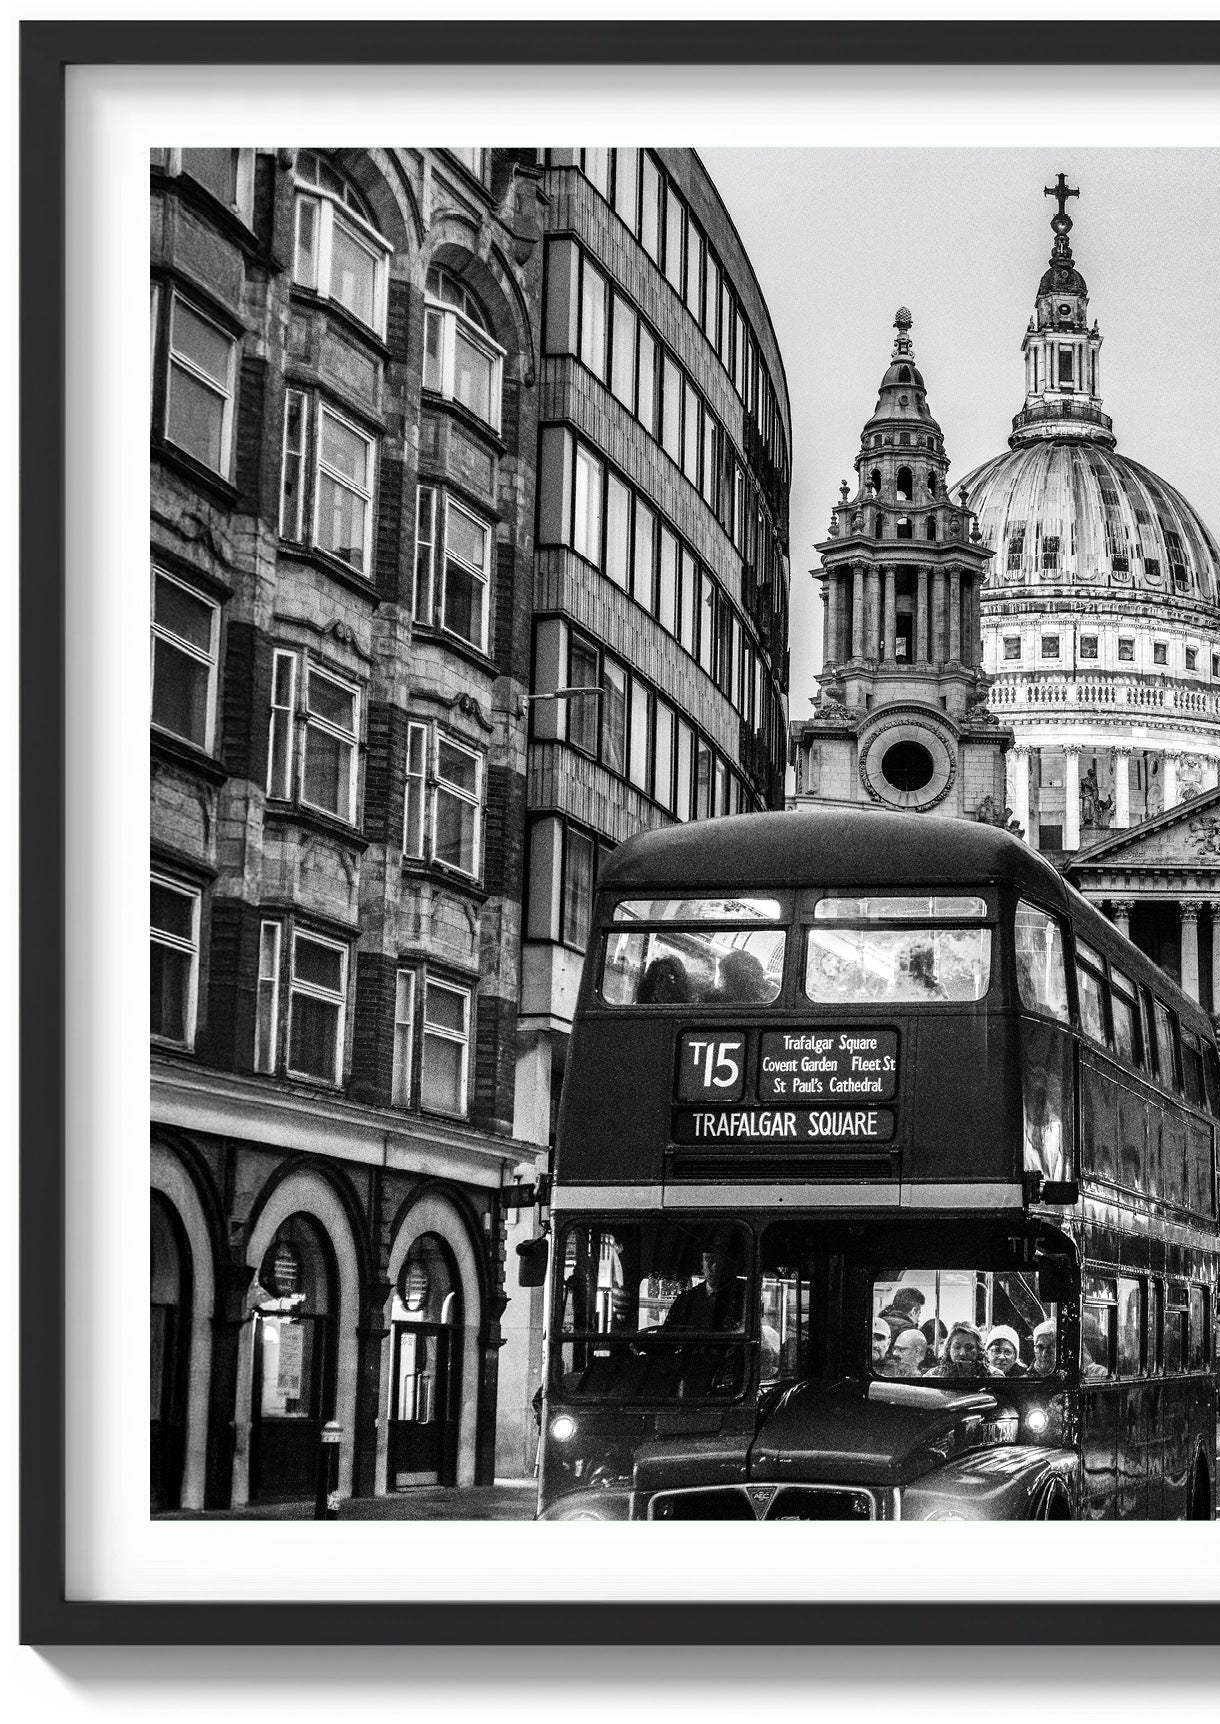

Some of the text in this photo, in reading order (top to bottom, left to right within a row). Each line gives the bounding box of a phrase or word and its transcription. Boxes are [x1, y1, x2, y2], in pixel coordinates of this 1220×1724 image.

[783, 1034, 878, 1054] Trafalgar Square
[688, 1041, 742, 1088] T15
[762, 1055, 896, 1072] Covent Garden Fleet St
[773, 1076, 883, 1093] St Paul's Cathedral
[692, 1111, 878, 1137] TRAFALGAR SQUARE
